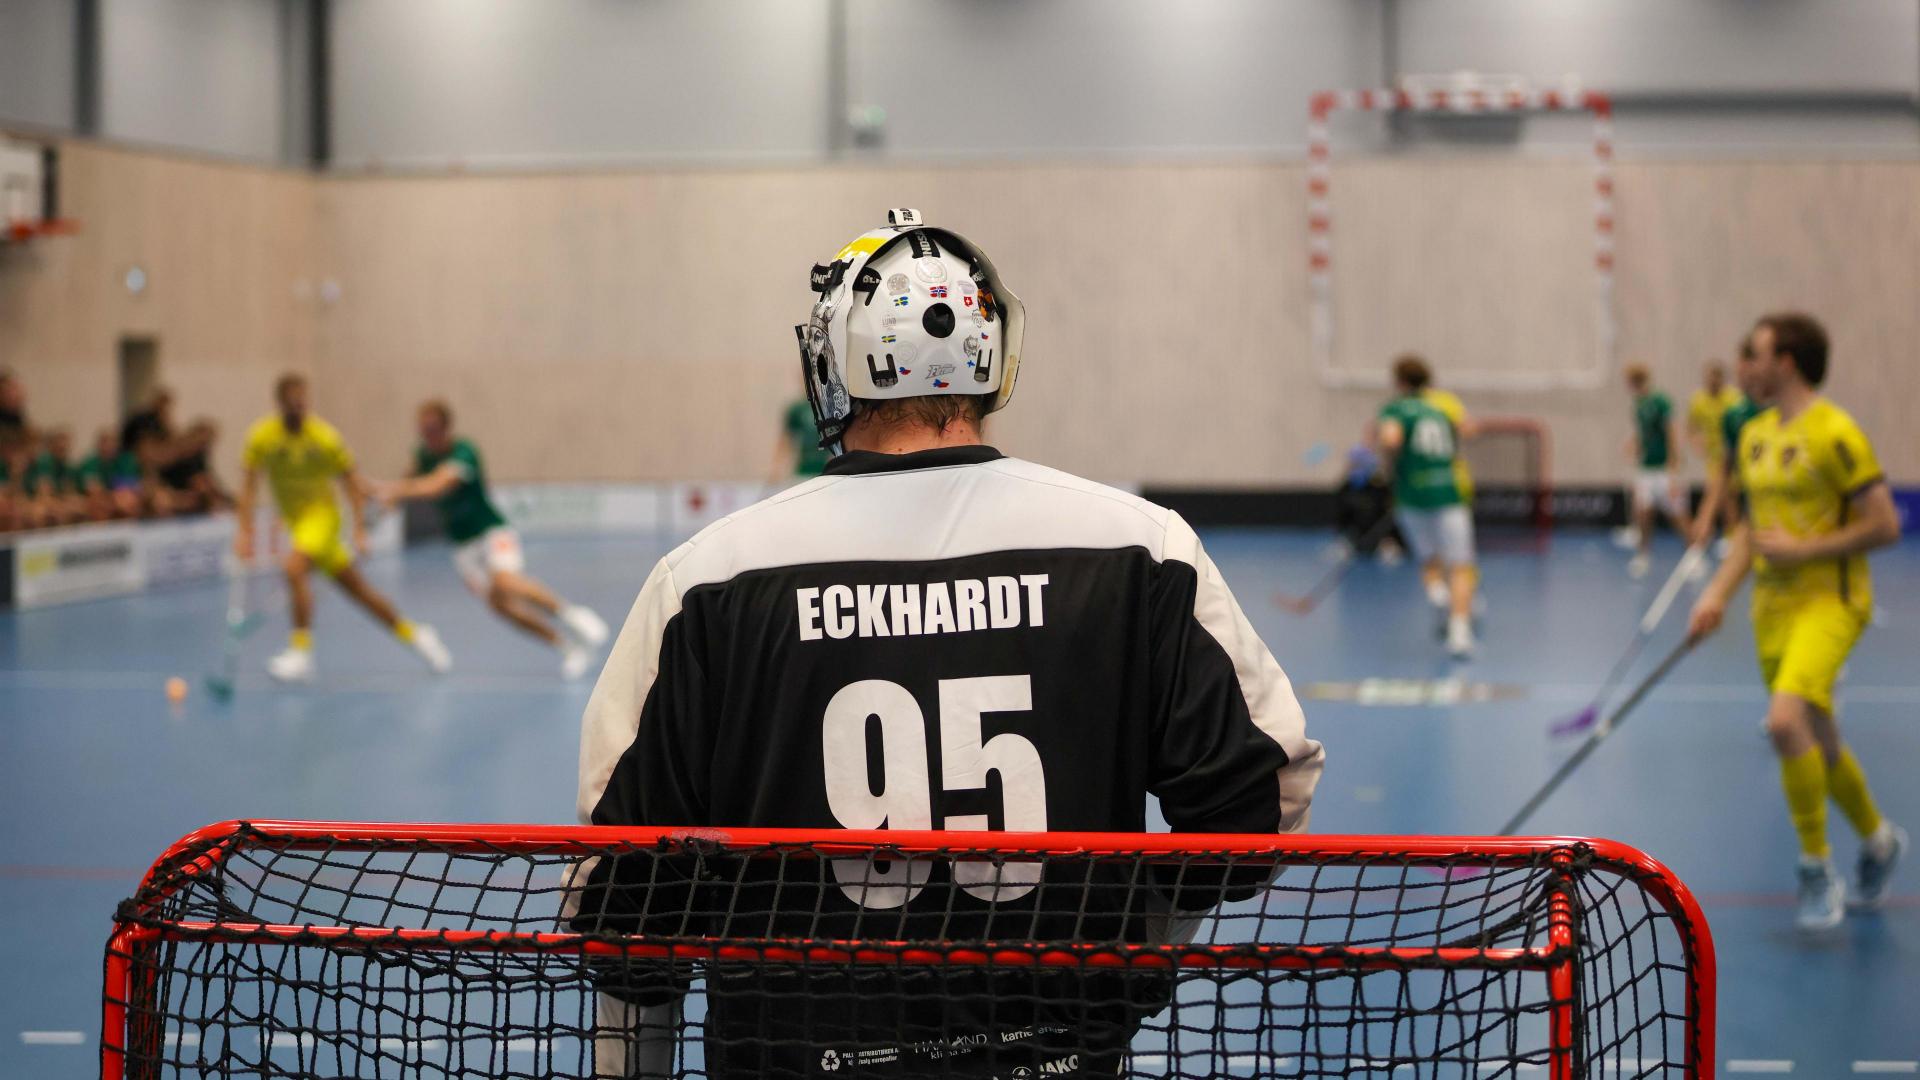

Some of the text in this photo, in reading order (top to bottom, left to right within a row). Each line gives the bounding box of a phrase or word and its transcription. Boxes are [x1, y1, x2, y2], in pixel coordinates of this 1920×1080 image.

[797, 573, 1049, 641] ECKHARDT
[822, 674, 1048, 910] 95
[930, 1050, 958, 1059] klia
[1039, 1053, 1079, 1079] JAKO
